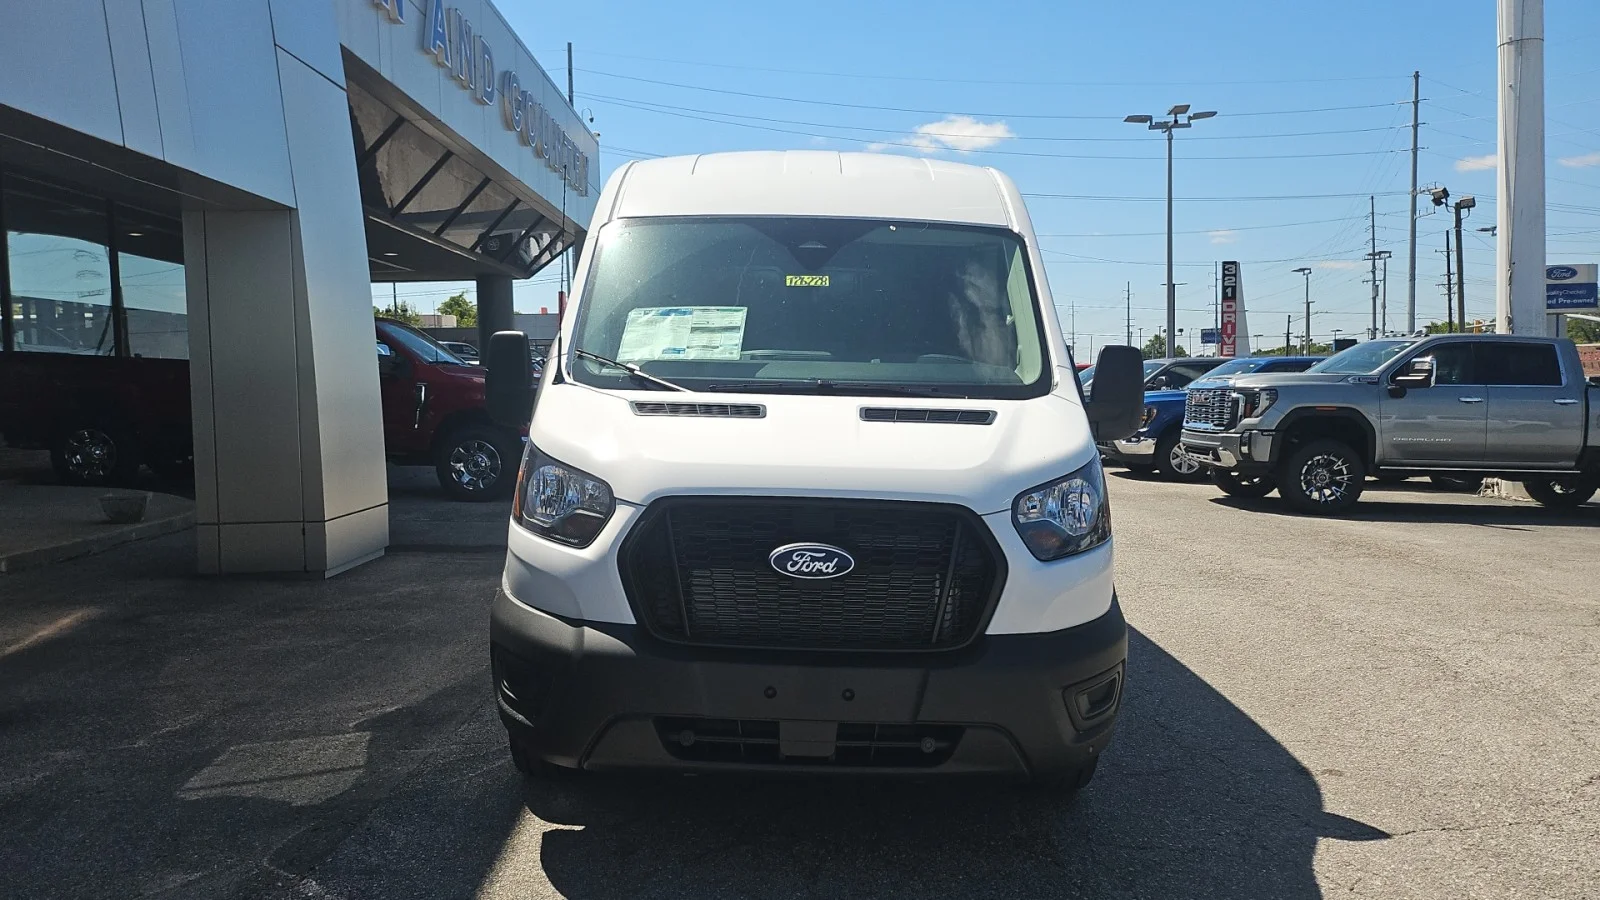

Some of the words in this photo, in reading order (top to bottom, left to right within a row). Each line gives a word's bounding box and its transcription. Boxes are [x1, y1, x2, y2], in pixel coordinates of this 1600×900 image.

[424, 0, 496, 106] AND
[1550, 269, 1572, 278] Ford
[1222, 301, 1236, 355] DRIVE
[786, 551, 839, 573] Ford
